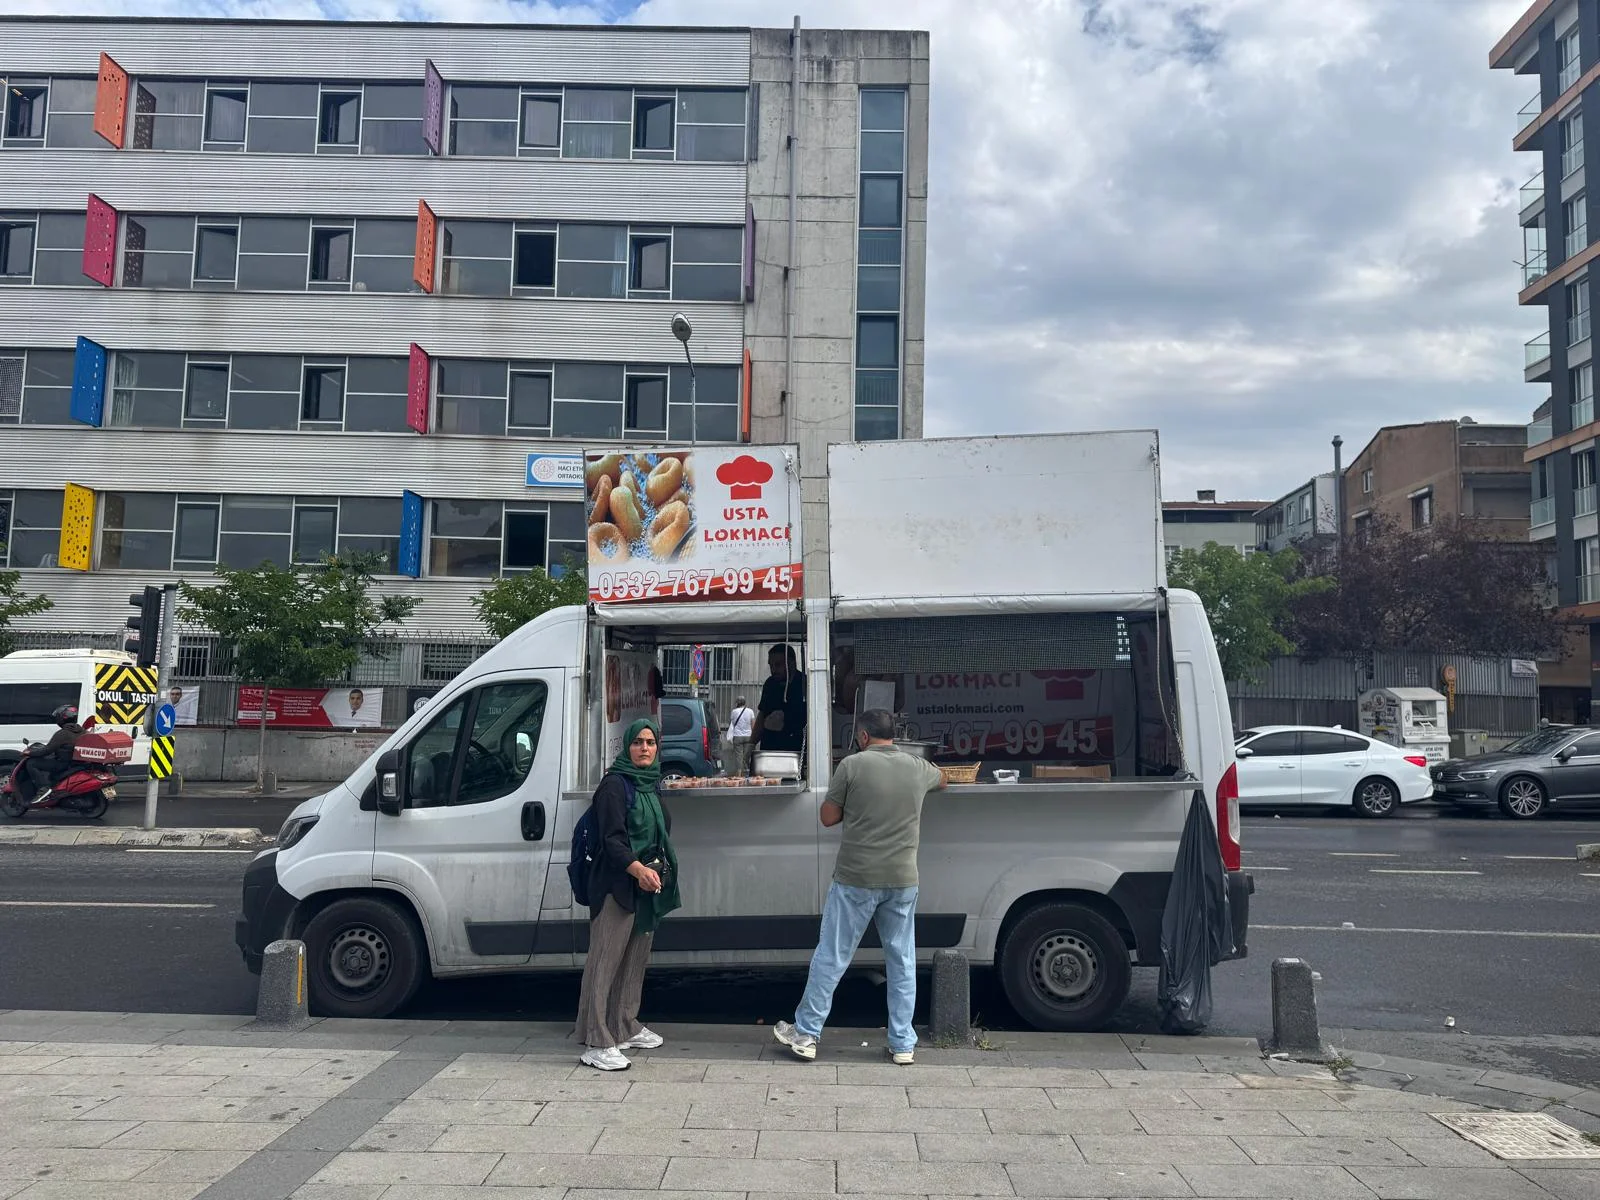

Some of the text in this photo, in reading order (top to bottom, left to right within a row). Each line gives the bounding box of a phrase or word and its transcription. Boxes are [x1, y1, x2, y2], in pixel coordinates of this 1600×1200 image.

[723, 507, 769, 521] USTA
[704, 526, 791, 542] LOKMACI
[598, 566, 794, 599] 0532 767 99 45
[915, 671, 1021, 690] LOKMACI
[98, 690, 124, 702] OKUL
[916, 703, 1025, 715] ustalokmaci.com
[1004, 718, 1045, 755] 99
[1056, 718, 1098, 755] 45
